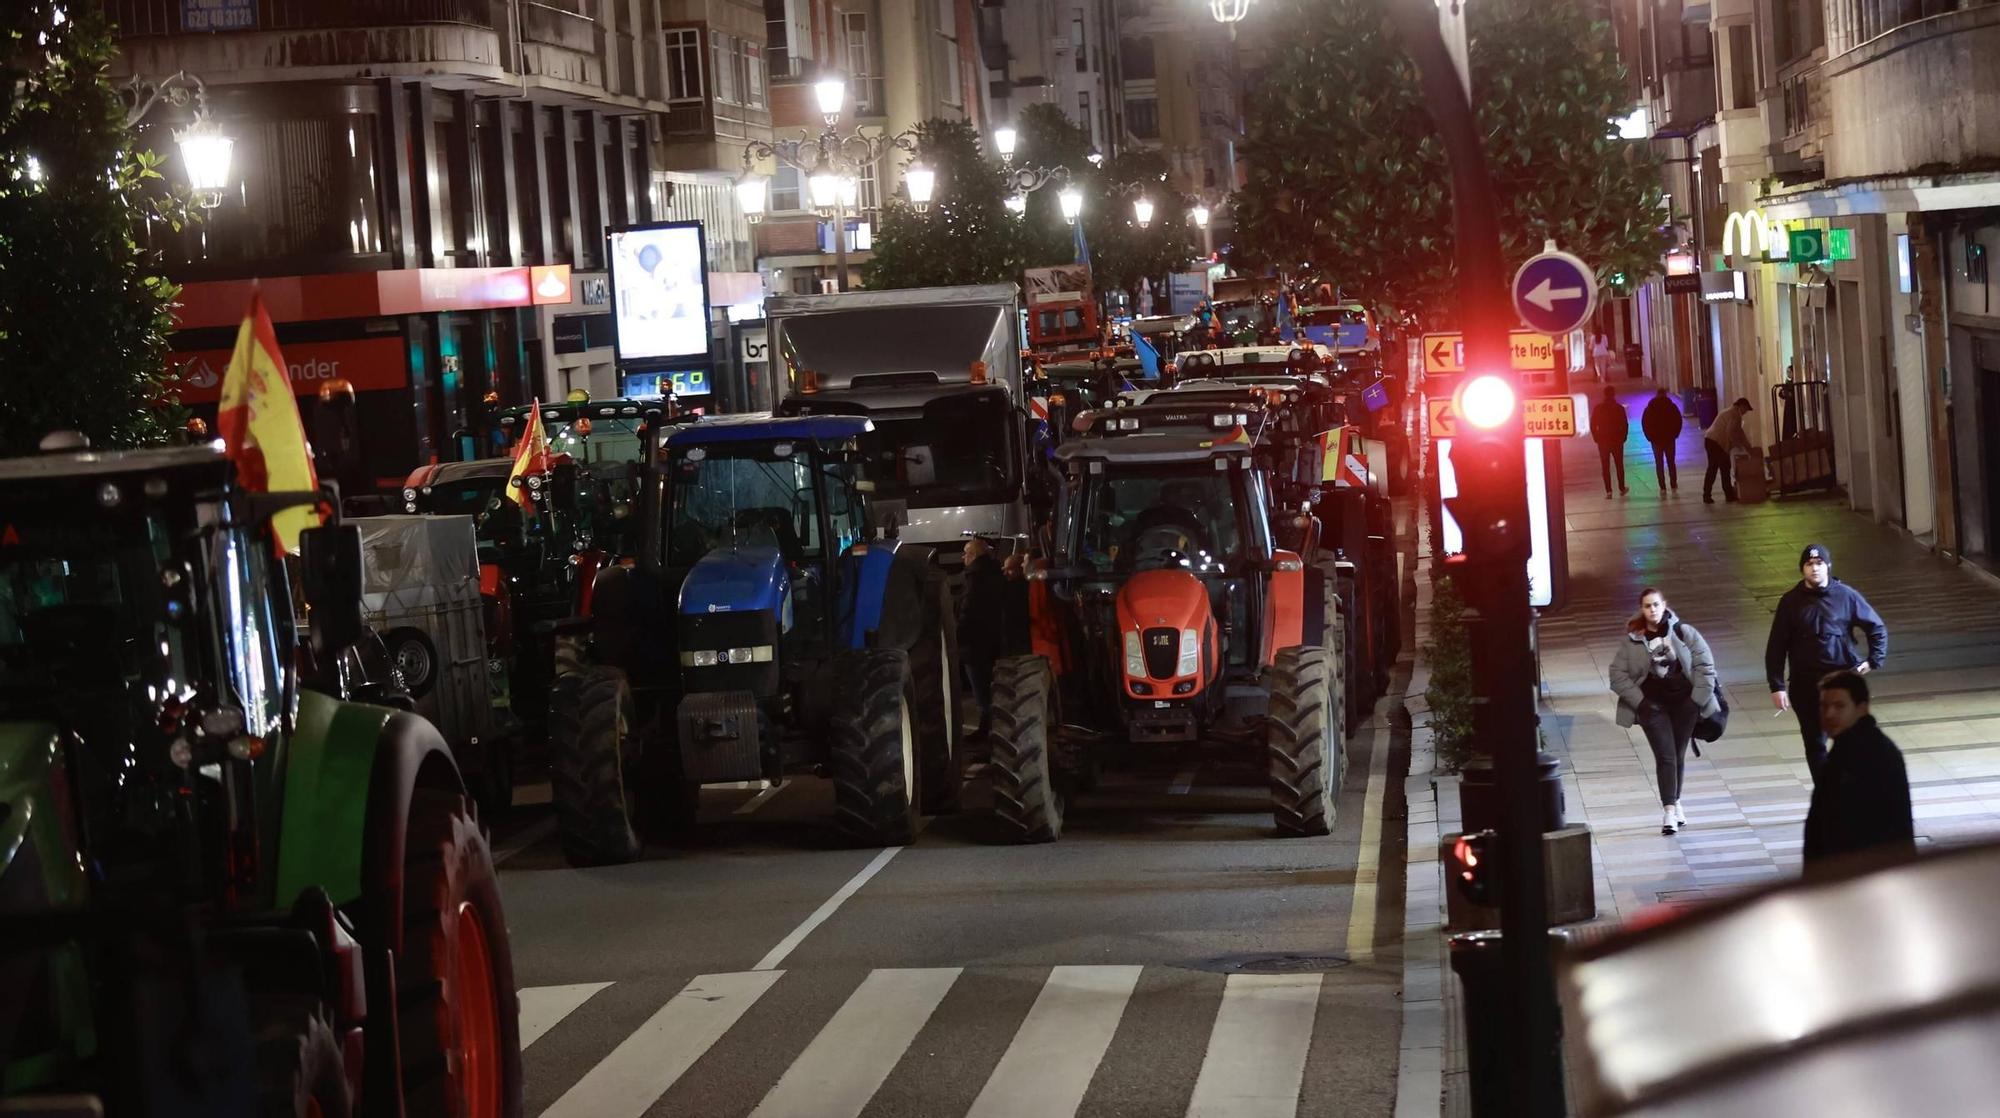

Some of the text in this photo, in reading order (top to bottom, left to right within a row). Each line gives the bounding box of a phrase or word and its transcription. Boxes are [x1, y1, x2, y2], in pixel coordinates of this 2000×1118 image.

[1530, 343, 1551, 360] Ingl
[1541, 403, 1553, 412] de
[1558, 402, 1568, 412] la
[1527, 418, 1569, 433] quista
